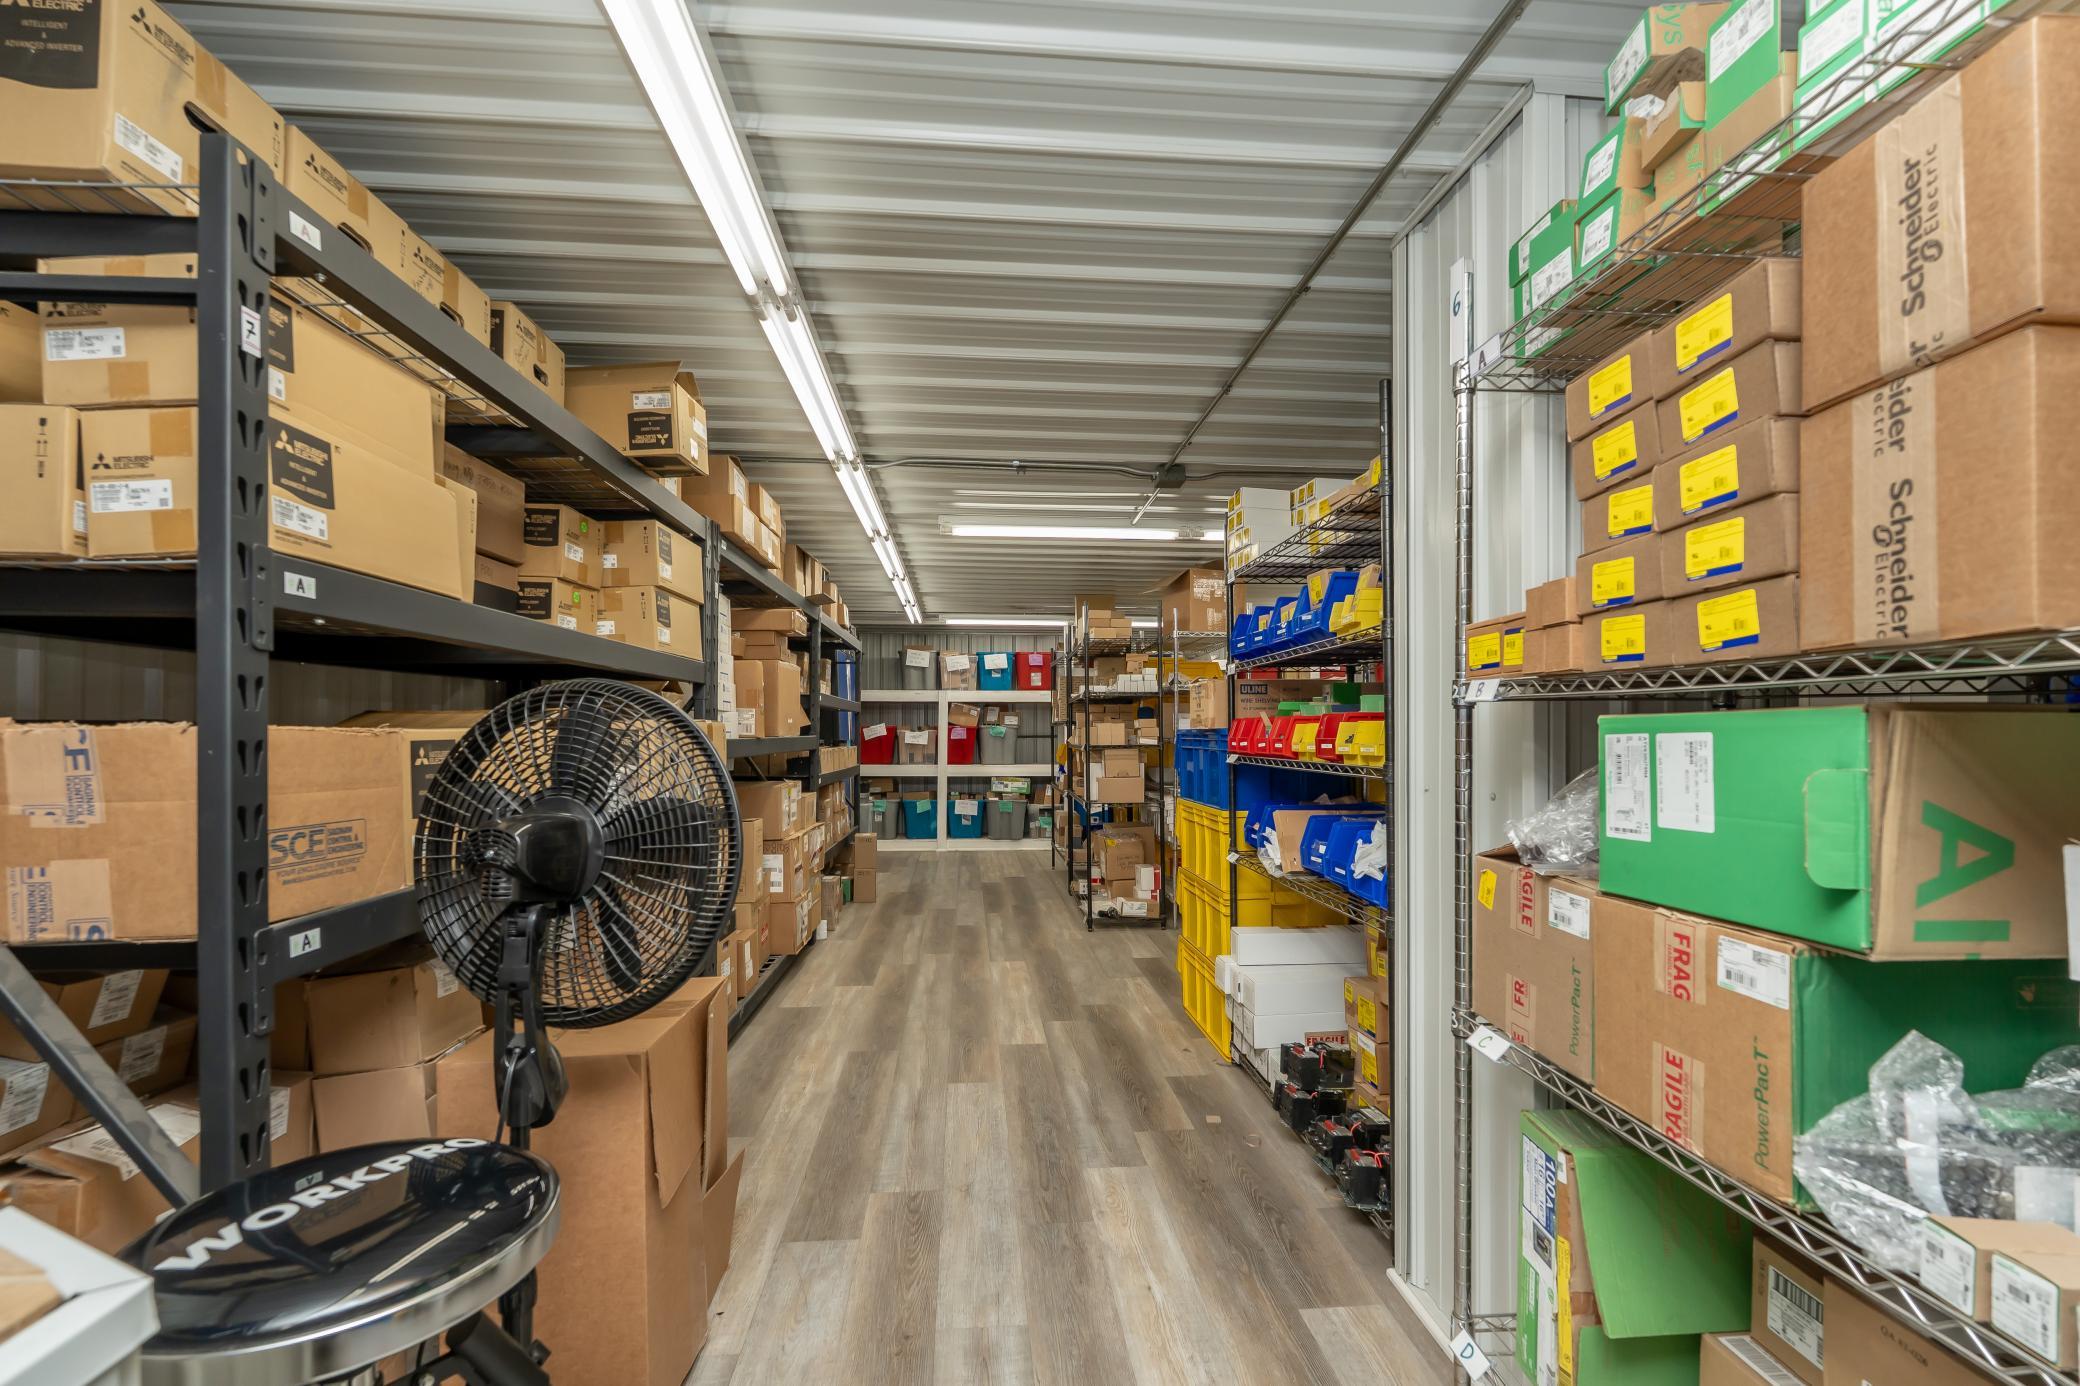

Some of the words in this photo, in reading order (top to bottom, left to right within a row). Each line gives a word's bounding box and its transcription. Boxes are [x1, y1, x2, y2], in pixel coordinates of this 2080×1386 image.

[32, 0, 84, 12] ELECTRIC
[1924, 143, 1940, 236] Electric
[300, 224, 312, 242] A
[1898, 158, 1926, 317] Schneider
[1452, 291, 1461, 317] 6
[1478, 349, 1488, 366] A
[1890, 477, 1914, 639] Schneider
[296, 577, 305, 593] A
[1874, 552, 1888, 640] Electric
[1241, 685, 1267, 694] ULINE
[271, 828, 325, 864] SCE
[38, 883, 49, 923] CONTROL
[1521, 870, 1534, 928] AGILE
[302, 933, 311, 951] A
[1673, 931, 1691, 1003] FRAG
[1514, 980, 1525, 1007] FR
[1478, 1035, 1493, 1048] C
[1664, 1050, 1683, 1141] RAGILE
[1755, 1048, 1770, 1170] PowerPacT
[154, 1138, 489, 1271] WORKPRO
[1460, 1342, 1474, 1359] D
